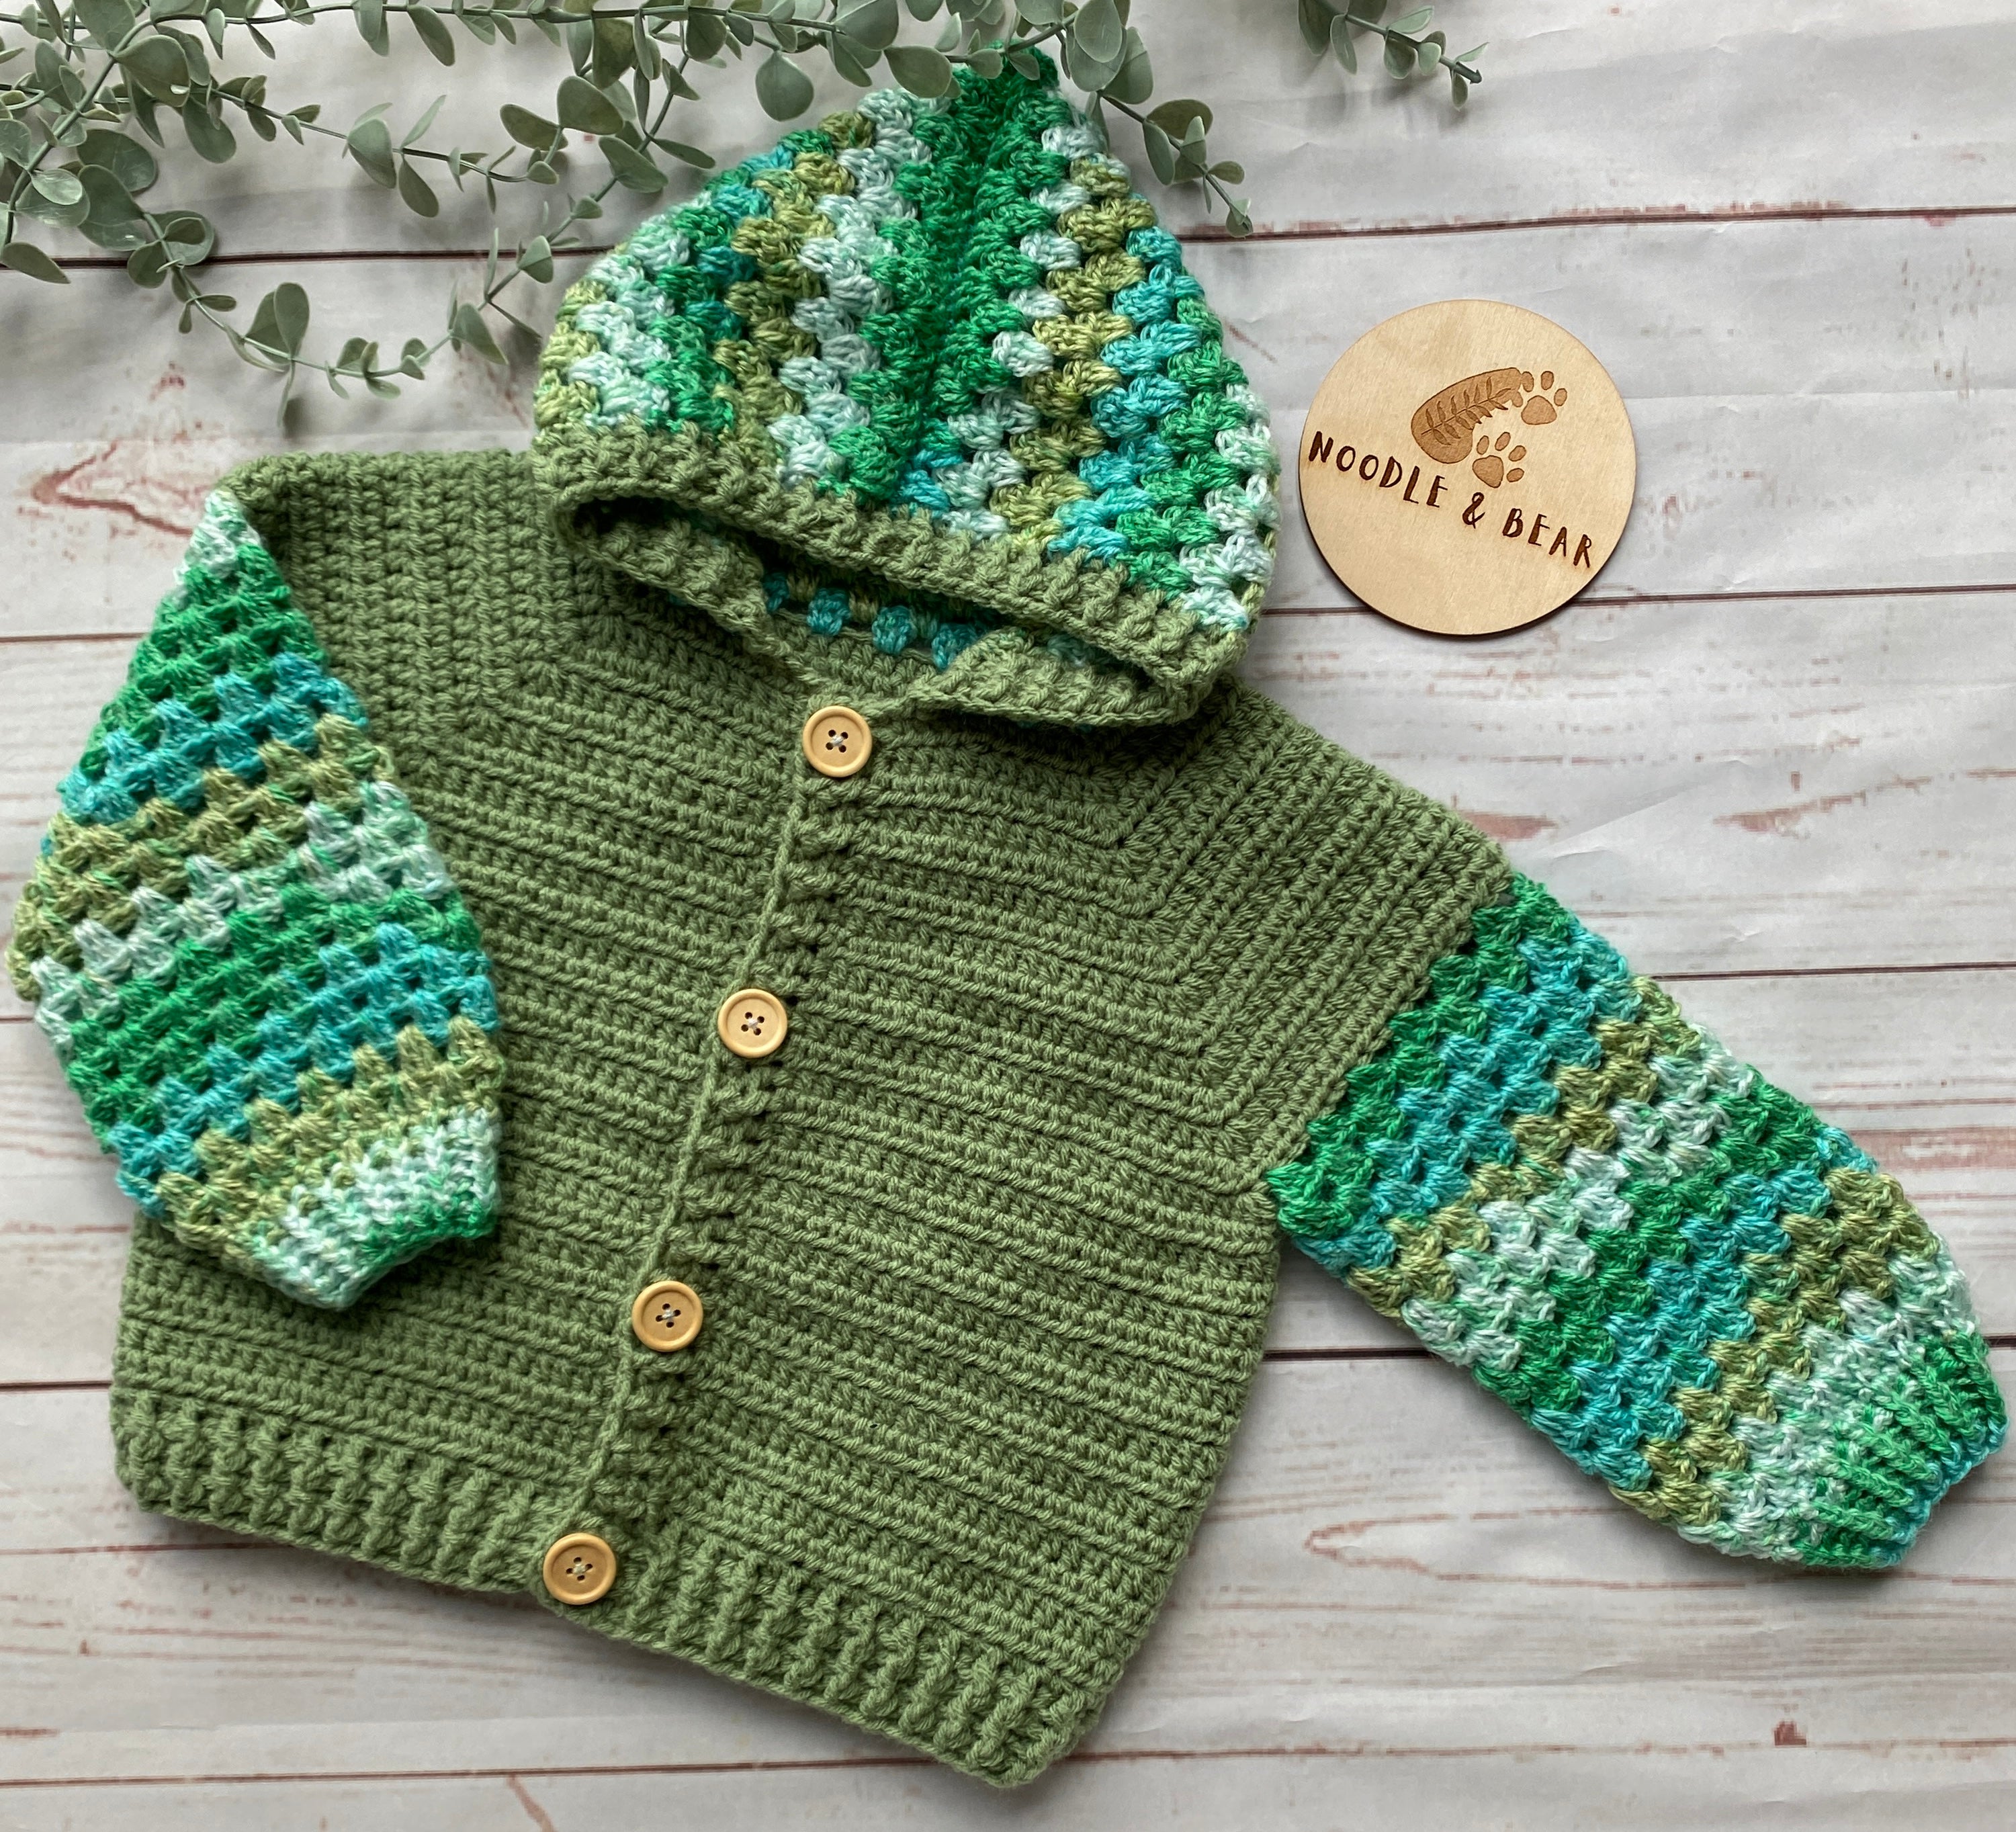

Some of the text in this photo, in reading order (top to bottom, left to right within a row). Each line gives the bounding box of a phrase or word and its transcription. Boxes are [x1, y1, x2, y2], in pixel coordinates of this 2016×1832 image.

[1308, 431, 1593, 568] NOODLE & BEAR
